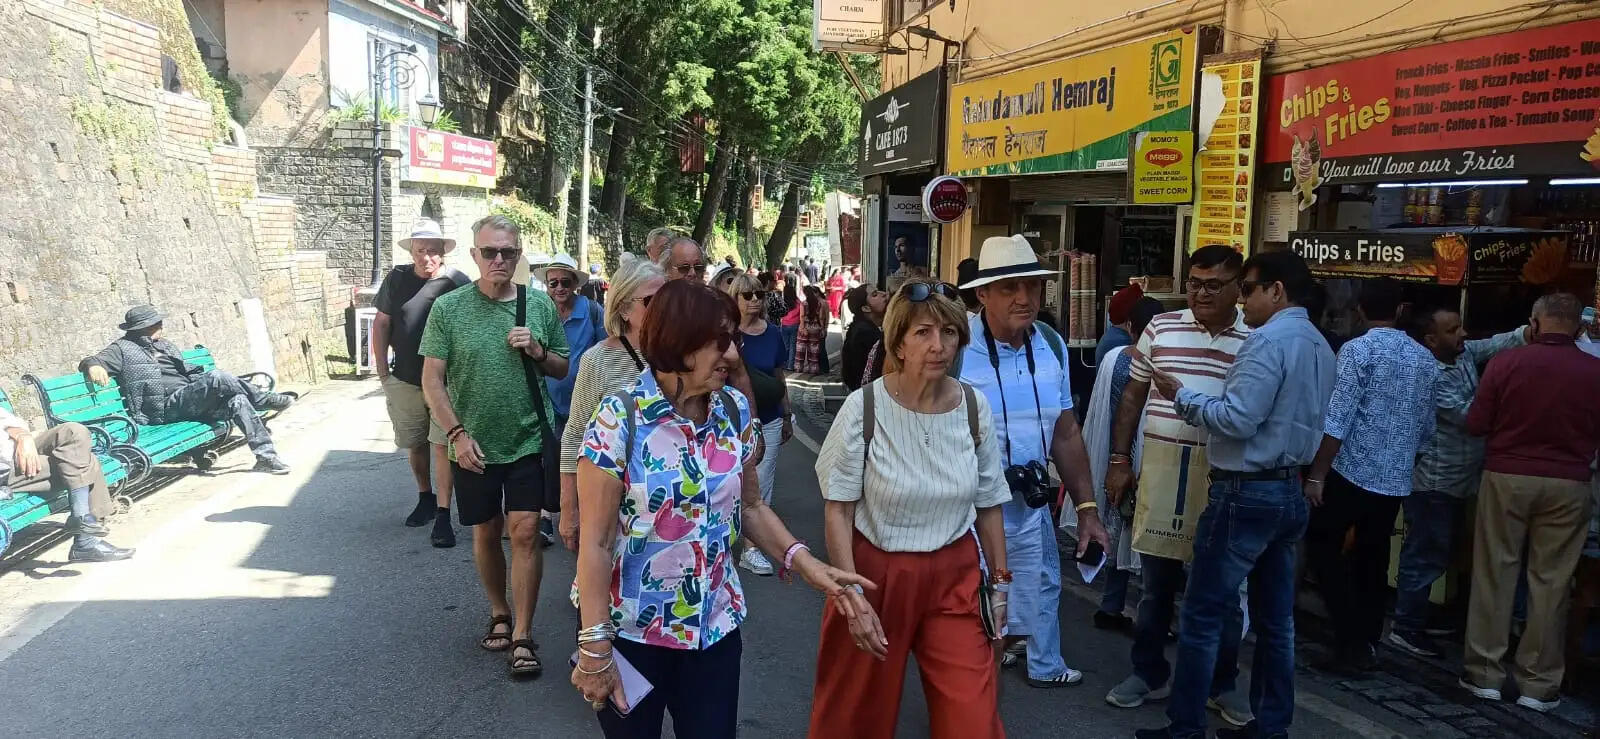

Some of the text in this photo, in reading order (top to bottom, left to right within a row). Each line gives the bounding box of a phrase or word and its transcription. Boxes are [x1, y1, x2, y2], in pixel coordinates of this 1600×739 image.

[839, 5, 864, 13] CHARM
[1395, 65, 1424, 80] French
[1426, 62, 1449, 76] Fries
[1455, 56, 1491, 72] Masala
[1493, 52, 1520, 67] Fries
[1528, 45, 1570, 62] Smiles
[1051, 67, 1116, 112] Hemraj
[1413, 82, 1450, 97] Nuggets
[1459, 79, 1479, 91] Veg.
[1482, 74, 1507, 88] Pizza
[1510, 69, 1549, 85] Pocket
[1559, 66, 1583, 80] Pop
[1280, 79, 1351, 128] Chips &
[1440, 99, 1476, 113] Cheese
[1477, 95, 1512, 109] Finger
[1522, 90, 1550, 104] Corn
[1552, 87, 1600, 102] Cheese
[1326, 98, 1391, 146] Fries
[1392, 123, 1416, 136] Sweet
[1418, 121, 1440, 134] Corn
[1446, 118, 1478, 132] Coffee
[1488, 115, 1507, 129] Tea
[1516, 111, 1560, 127] Tomato
[1562, 107, 1595, 123] Soup
[892, 126, 908, 146] 1873
[1005, 126, 1048, 157] हेमराज
[1150, 136, 1178, 144] MOMO'S
[1149, 153, 1178, 161] Maggi
[1322, 149, 1516, 183] You will love our Fries
[1139, 187, 1188, 196] SWEET CORN
[893, 202, 921, 211] JOCKE
[1292, 239, 1406, 265] Chips & Fries
[1474, 240, 1505, 261] Chips
[1499, 243, 1527, 262] Fries
[1145, 528, 1185, 540] NUMERO
